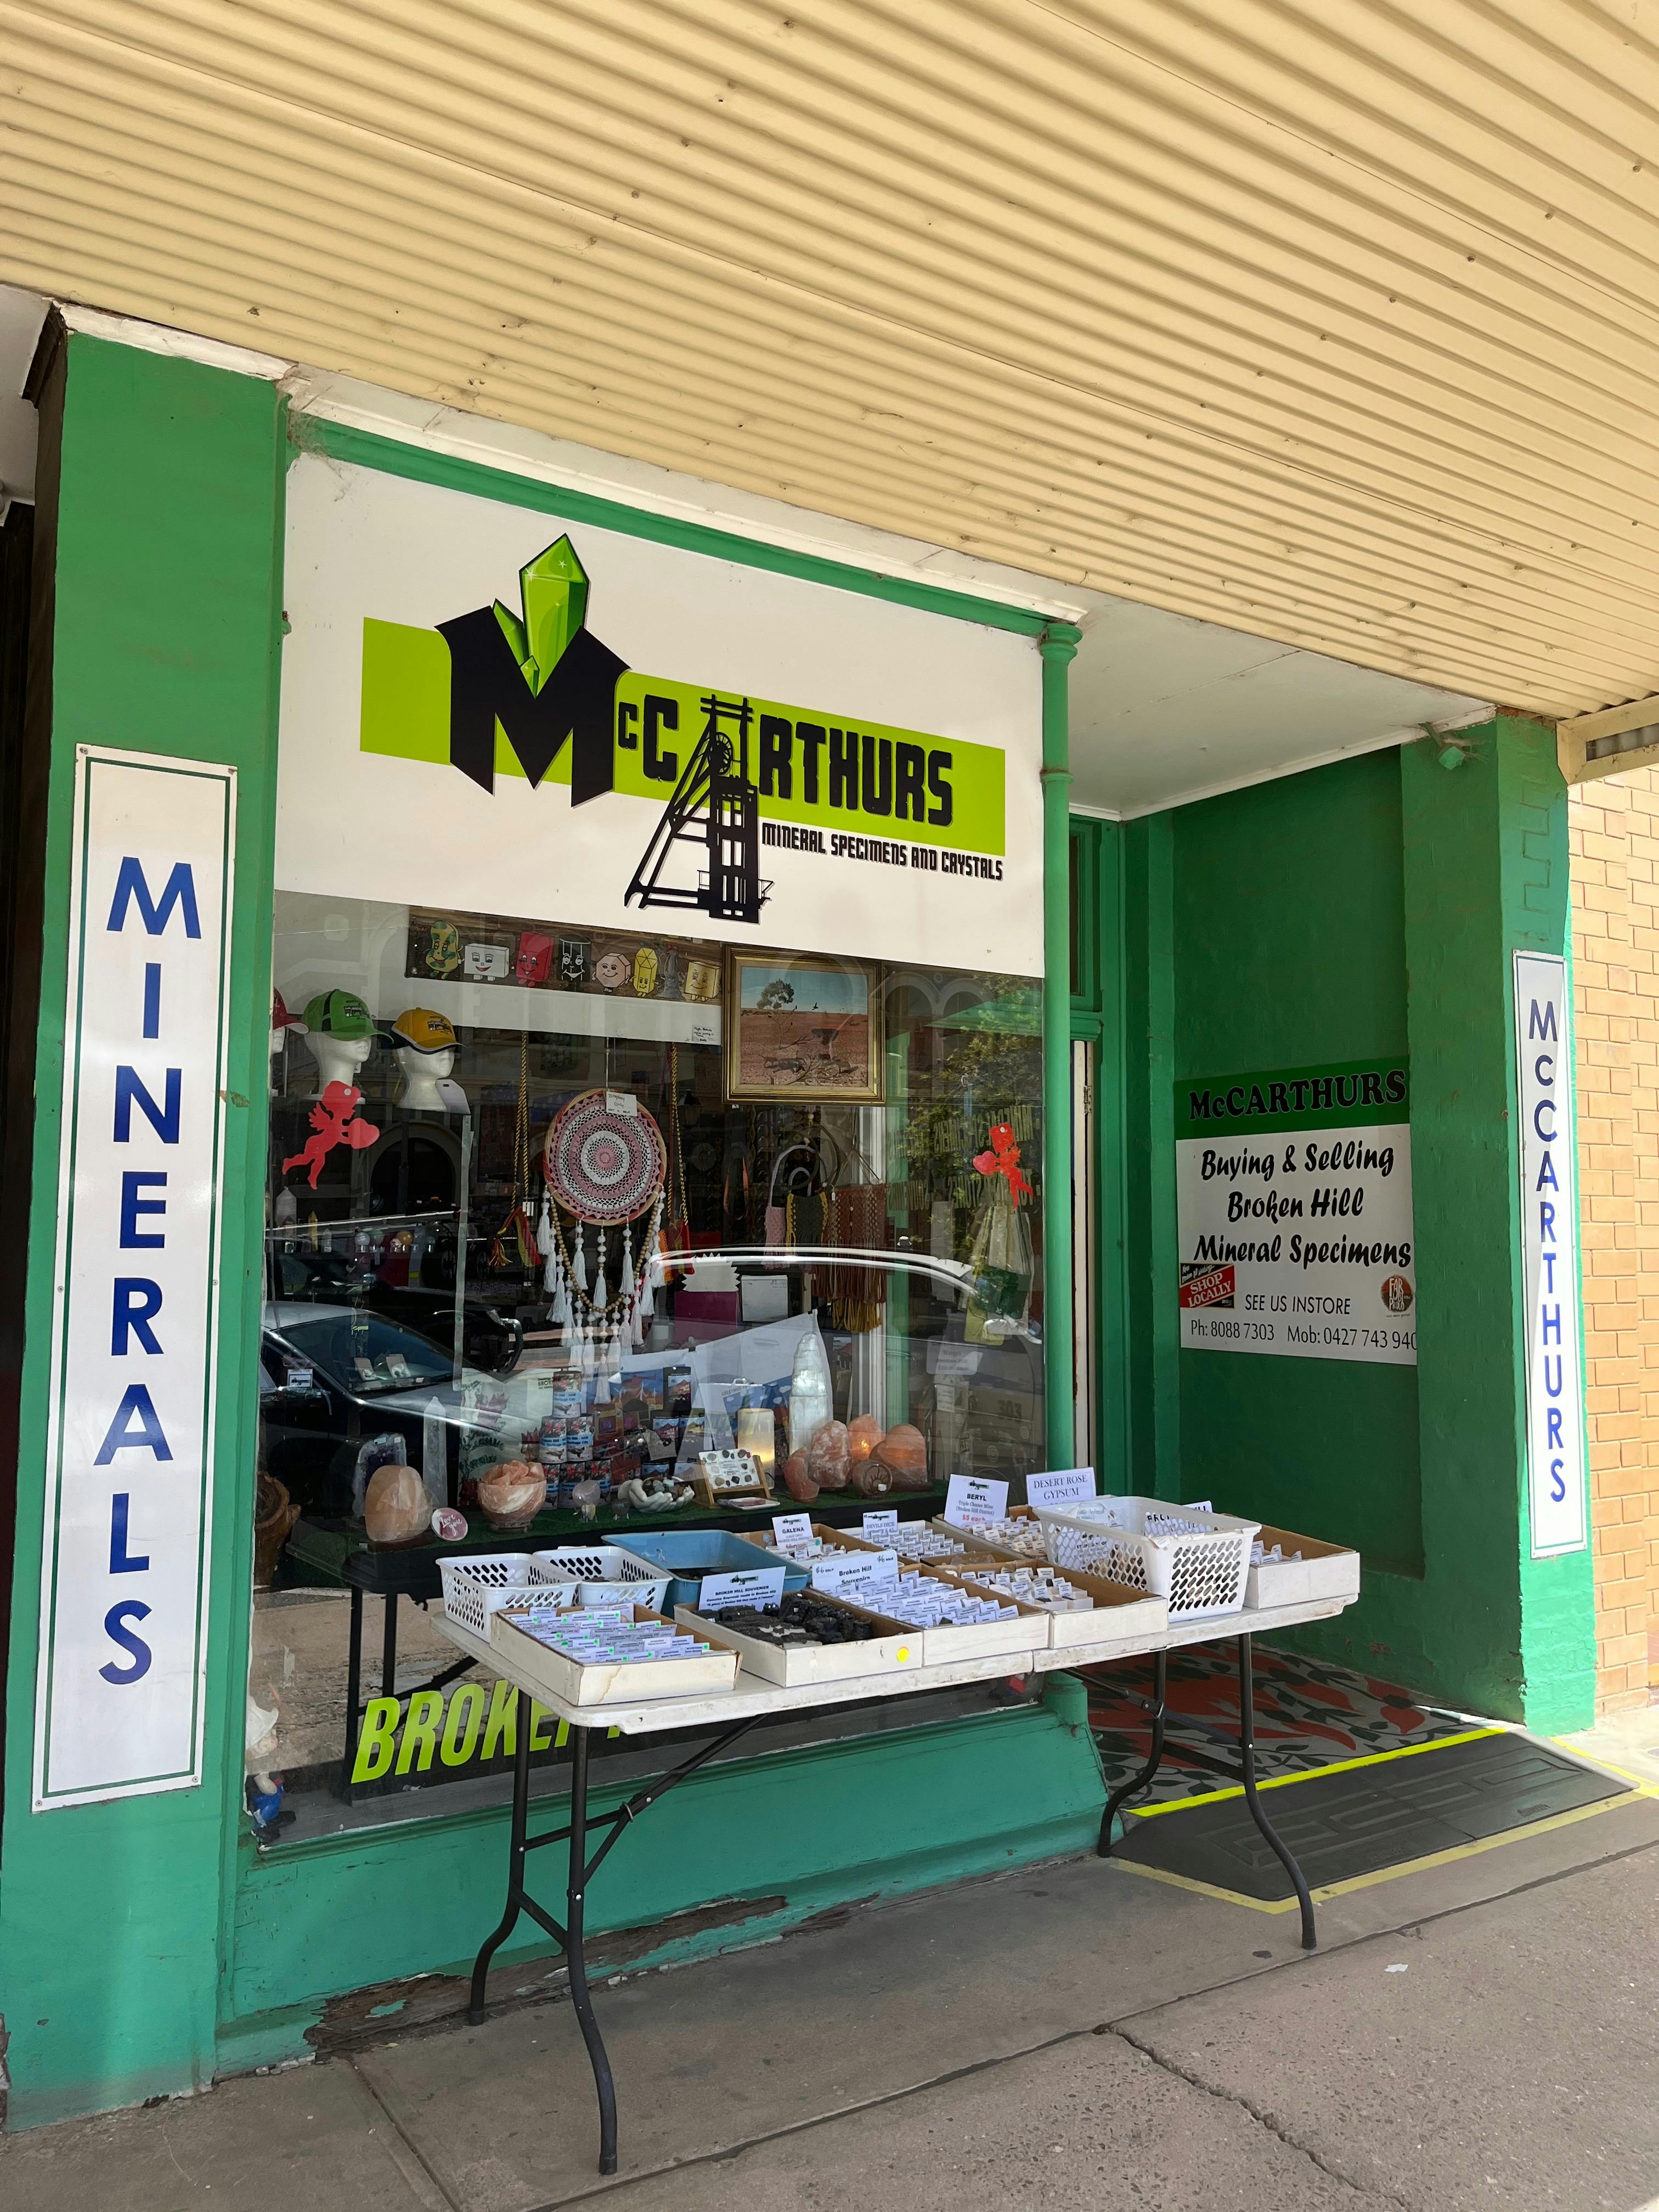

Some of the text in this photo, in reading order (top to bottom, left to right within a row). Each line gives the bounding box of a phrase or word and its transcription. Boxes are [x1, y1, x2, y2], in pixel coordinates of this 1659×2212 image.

[762, 822, 1003, 881] MINERAL SPECIMENS AND CRYSTALS
[1189, 1069, 1407, 1120] McCARTHURS
[1201, 1140, 1394, 1181] Buying & Selling
[1227, 1187, 1364, 1224] Broken Hill
[1193, 1234, 1412, 1269] Mineral Specimens
[93, 856, 201, 1685] MINERALS
[1190, 1273, 1223, 1294] SHOP
[1187, 1280, 1232, 1308] LOCALLY
[1245, 1294, 1265, 1312] SEE
[1271, 1295, 1288, 1312] US
[1293, 1295, 1351, 1315] INSTORE
[1191, 1319, 1208, 1336] Ph:
[1211, 1321, 1240, 1338] 8088
[1243, 1323, 1275, 1340] 7303
[1288, 1325, 1321, 1344] Mob:
[1324, 1327, 1357, 1346] 0427
[1361, 1329, 1388, 1348] 743
[1034, 1474, 1088, 1488] DESERT ROSE
[1043, 1487, 1080, 1500] GYPSUM
[439, 1514, 455, 1528] Love
[449, 1519, 463, 1536] you
[839, 1568, 860, 1576] Broken
[841, 1576, 871, 1585] Souvenirs
[351, 1680, 571, 1783] BROKE
